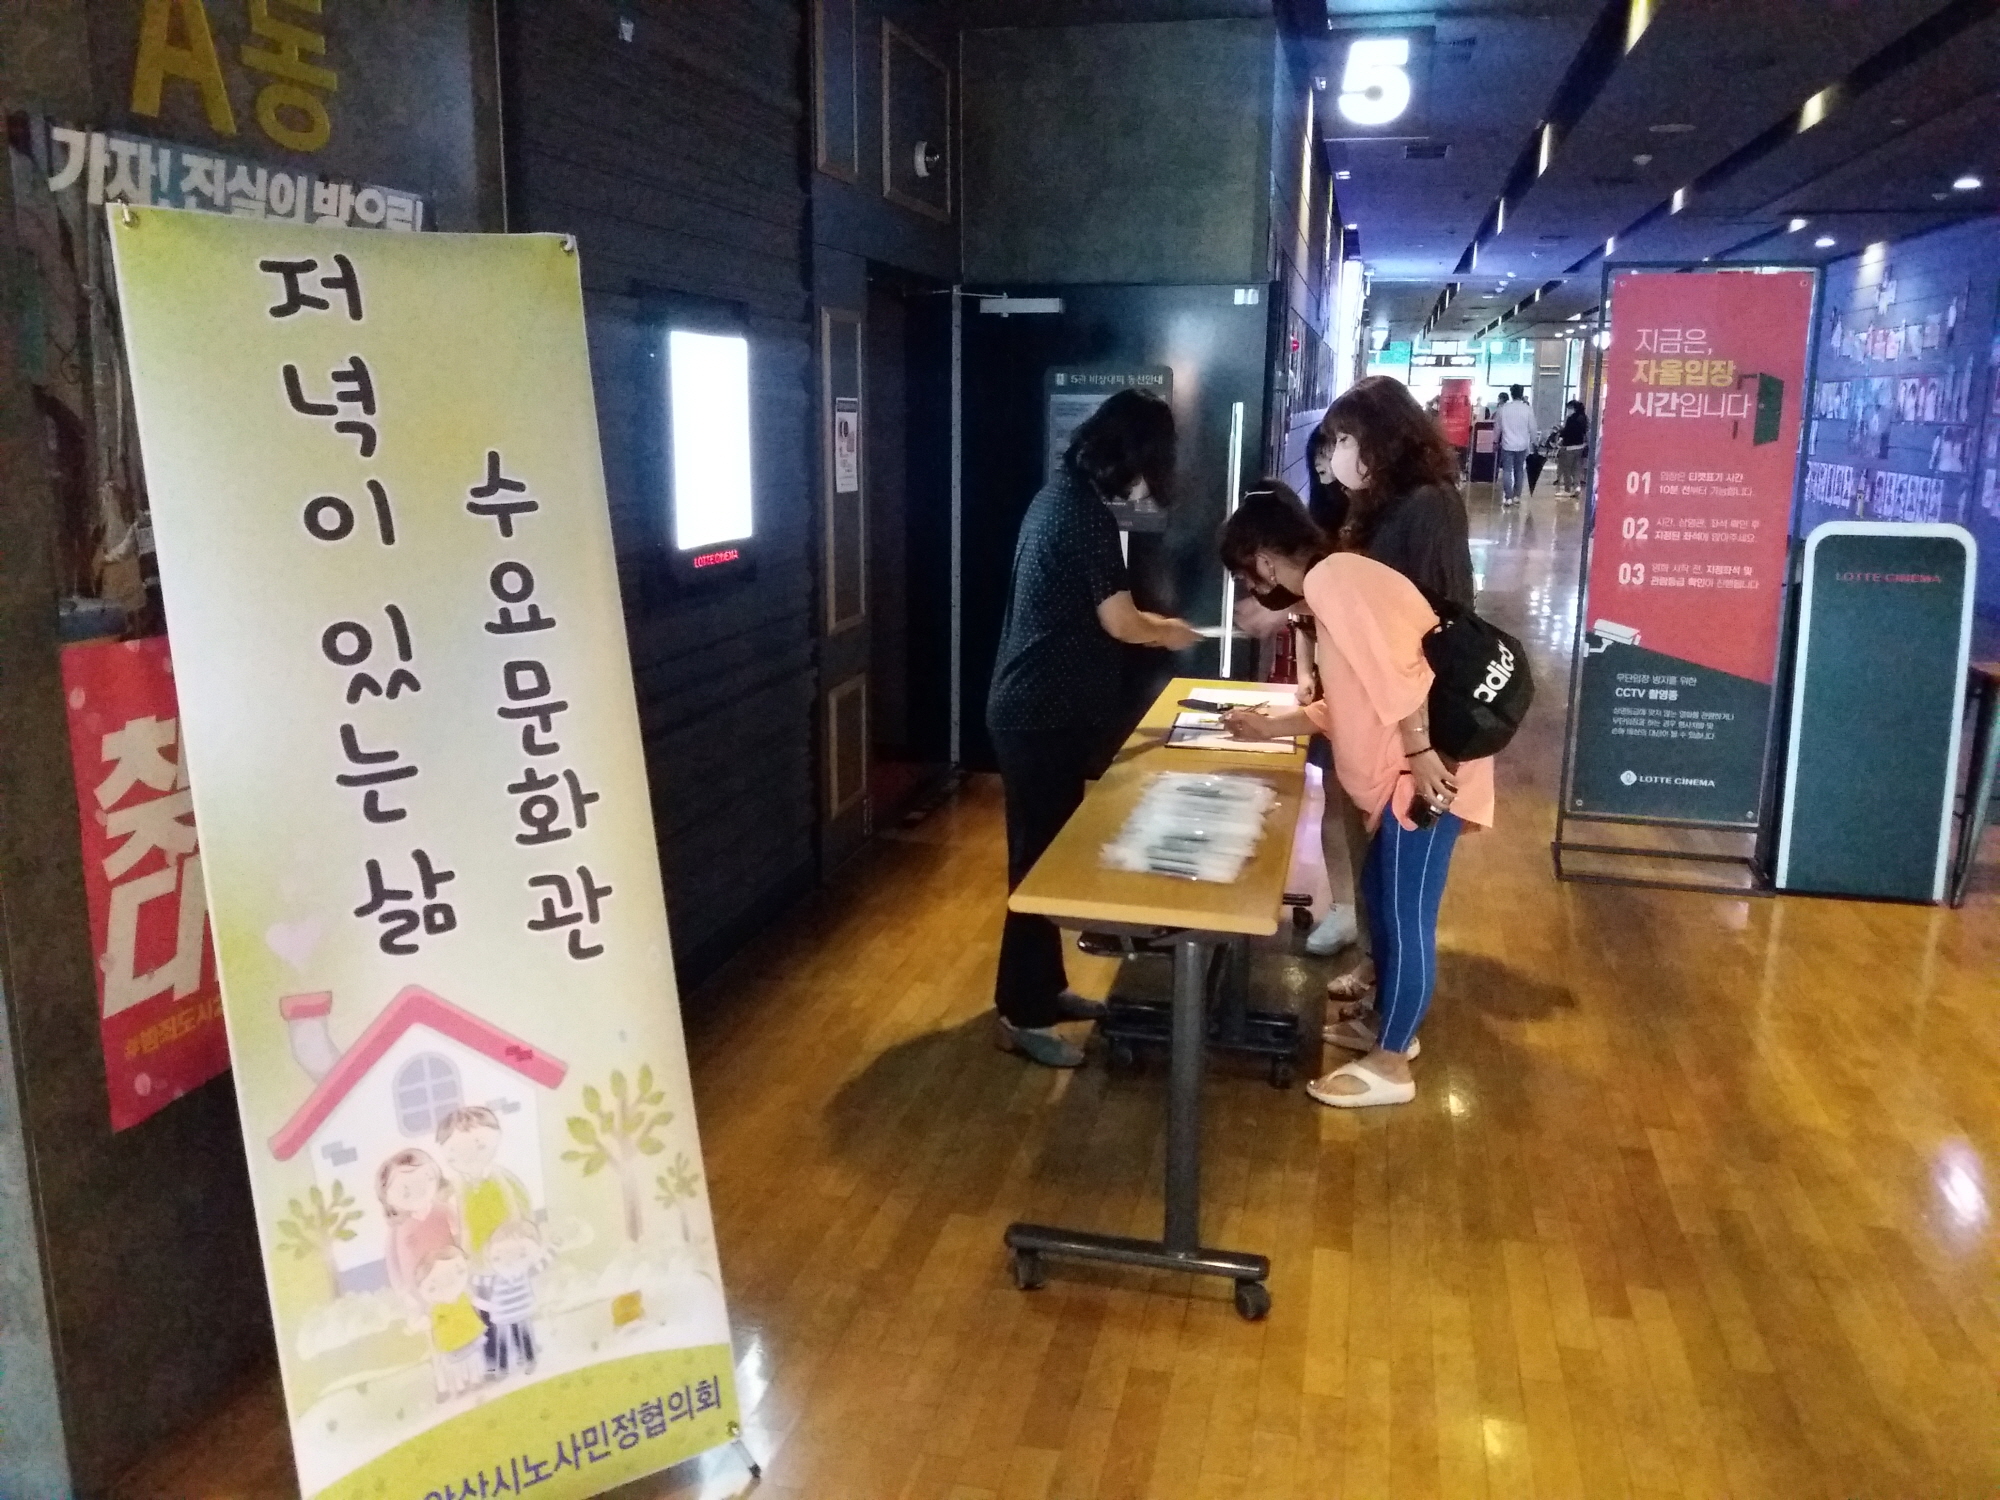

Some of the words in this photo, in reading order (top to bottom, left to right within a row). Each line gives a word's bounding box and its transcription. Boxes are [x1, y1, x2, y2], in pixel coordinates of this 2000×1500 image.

[1338, 39, 1410, 125] 5
[1635, 328, 1713, 355] 지금은,
[1632, 359, 1736, 387] 자율입장
[258, 252, 396, 547] 저녁이
[1629, 392, 1752, 419] 시간입니다
[1626, 471, 1651, 495] 01
[1726, 472, 1744, 483] 시간
[1622, 517, 1649, 540] 02
[1618, 562, 1645, 585] 03
[1615, 687, 1646, 698] CCTV
[321, 603, 422, 825] 있는
[1639, 775, 1672, 785] LOTTE
[1674, 777, 1716, 788] CINEMA
[353, 848, 456, 956] 삶
